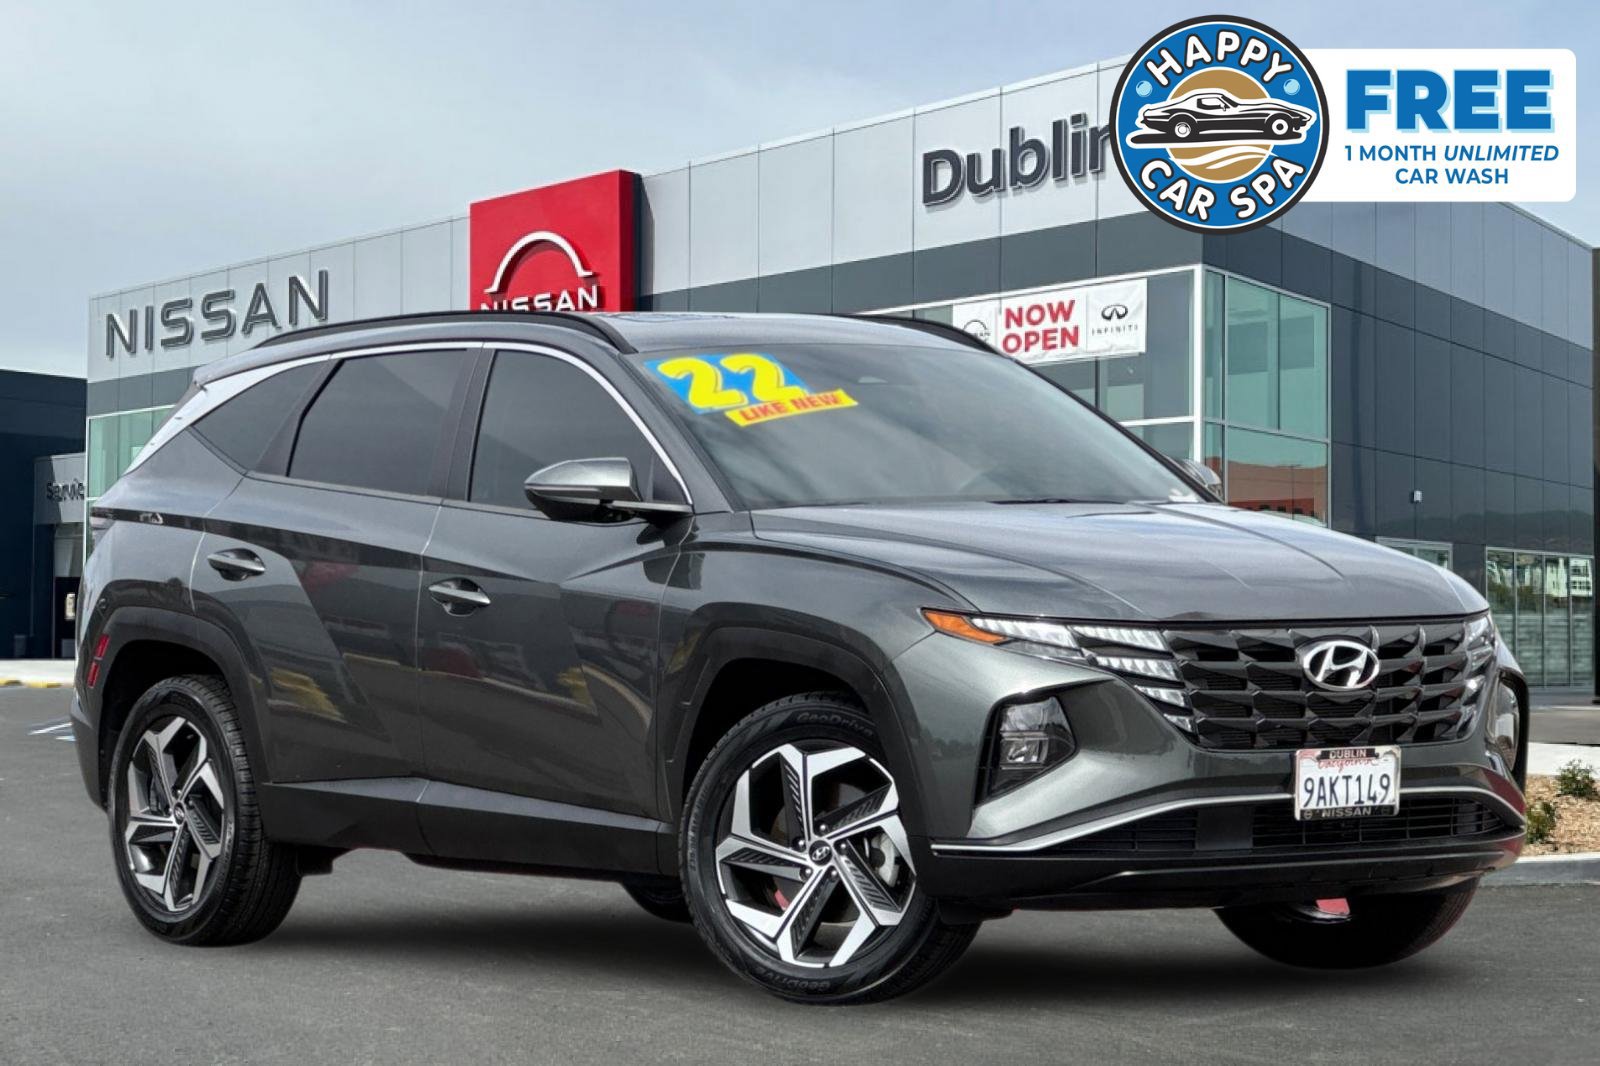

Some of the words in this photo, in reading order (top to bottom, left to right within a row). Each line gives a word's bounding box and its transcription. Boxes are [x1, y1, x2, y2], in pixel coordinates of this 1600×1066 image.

[106, 269, 329, 360] NISSAN
[1005, 300, 1076, 329] NOW
[1002, 326, 1080, 353] OPEN
[657, 353, 810, 409] 22
[740, 402, 787, 424] LIKE
[791, 392, 841, 413] NEW
[1328, 748, 1368, 760] DUBLIN
[1303, 773, 1391, 808] 9AKT149
[1321, 806, 1372, 818] NISSAN
